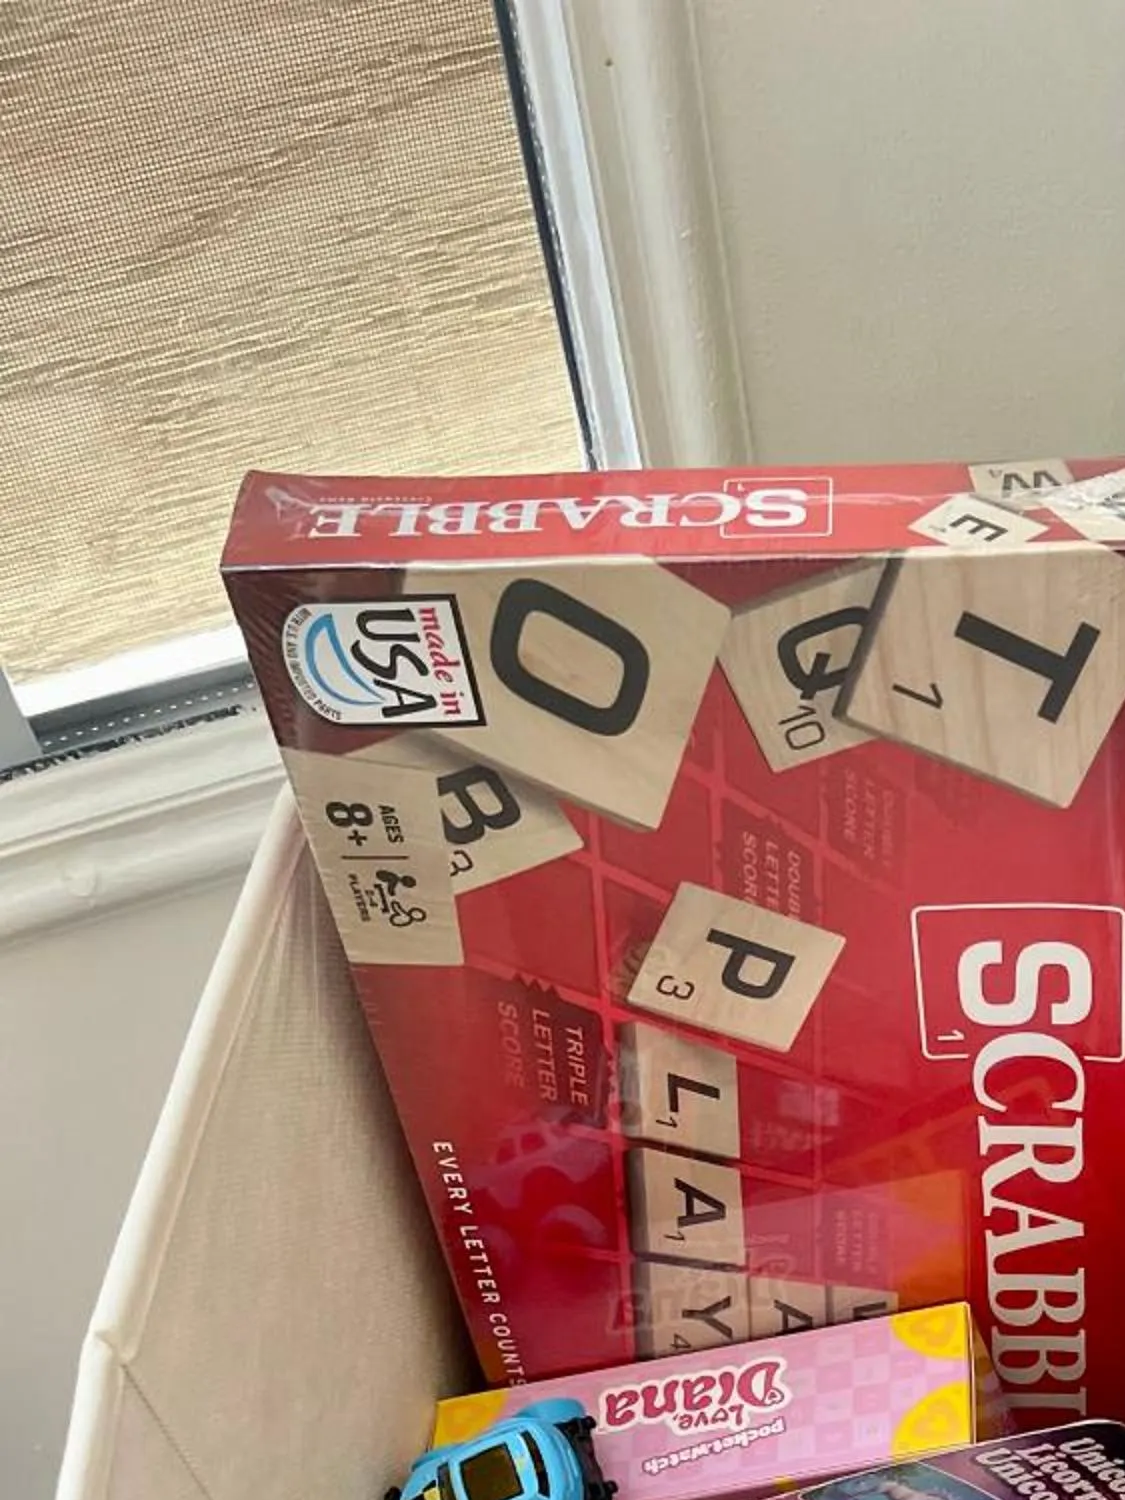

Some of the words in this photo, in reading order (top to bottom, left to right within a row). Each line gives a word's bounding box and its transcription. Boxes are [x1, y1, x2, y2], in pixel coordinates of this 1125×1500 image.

[309, 487, 808, 538] SCRABBLE
[950, 513, 1009, 541] E
[350, 608, 438, 718] USA
[418, 607, 461, 683] made
[440, 691, 465, 716] in
[490, 578, 650, 737] O
[777, 606, 870, 701] Q
[954, 610, 1101, 724] T
[778, 704, 825, 752] 10
[891, 682, 943, 710] 1
[325, 801, 374, 846] 8+
[378, 804, 405, 844] AGES
[436, 764, 521, 846] B
[764, 840, 781, 911] LETTE
[787, 850, 802, 918] DOUB
[655, 974, 695, 1002] 3
[705, 928, 796, 1001] P
[498, 1001, 526, 1090] SCORE
[531, 1006, 558, 1101] LETTER
[564, 1025, 590, 1107] TRIPLE
[655, 1116, 679, 1131] 1
[667, 1072, 721, 1114] L
[674, 1178, 727, 1229] A
[957, 941, 1093, 1417] SCRABBL
[432, 1140, 474, 1215] EVERY
[459, 1224, 501, 1304] LETTER
[681, 1295, 733, 1341] Y
[605, 1361, 785, 1427] Diana
[641, 1416, 787, 1476] pocket.watch
